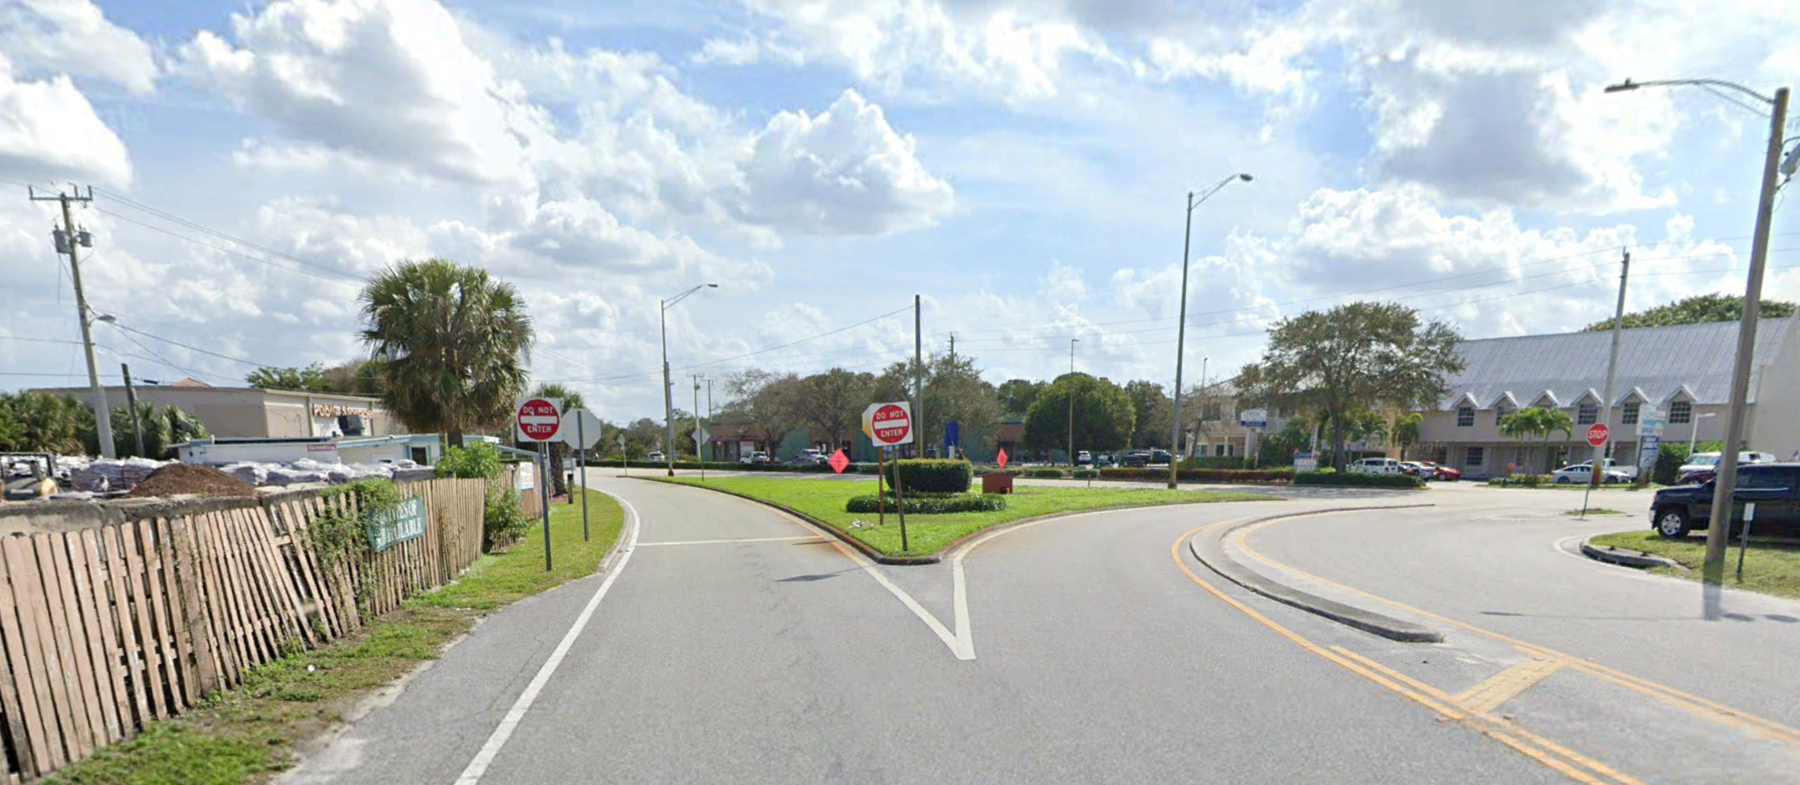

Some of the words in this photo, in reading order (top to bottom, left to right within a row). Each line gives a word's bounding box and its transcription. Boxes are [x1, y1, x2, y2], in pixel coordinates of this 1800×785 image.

[523, 406, 534, 414] DO
[538, 406, 553, 414] NOT
[876, 412, 886, 420] DO
[890, 411, 904, 419] NOT
[881, 429, 903, 438] ENTER
[1589, 430, 1608, 439] STOP
